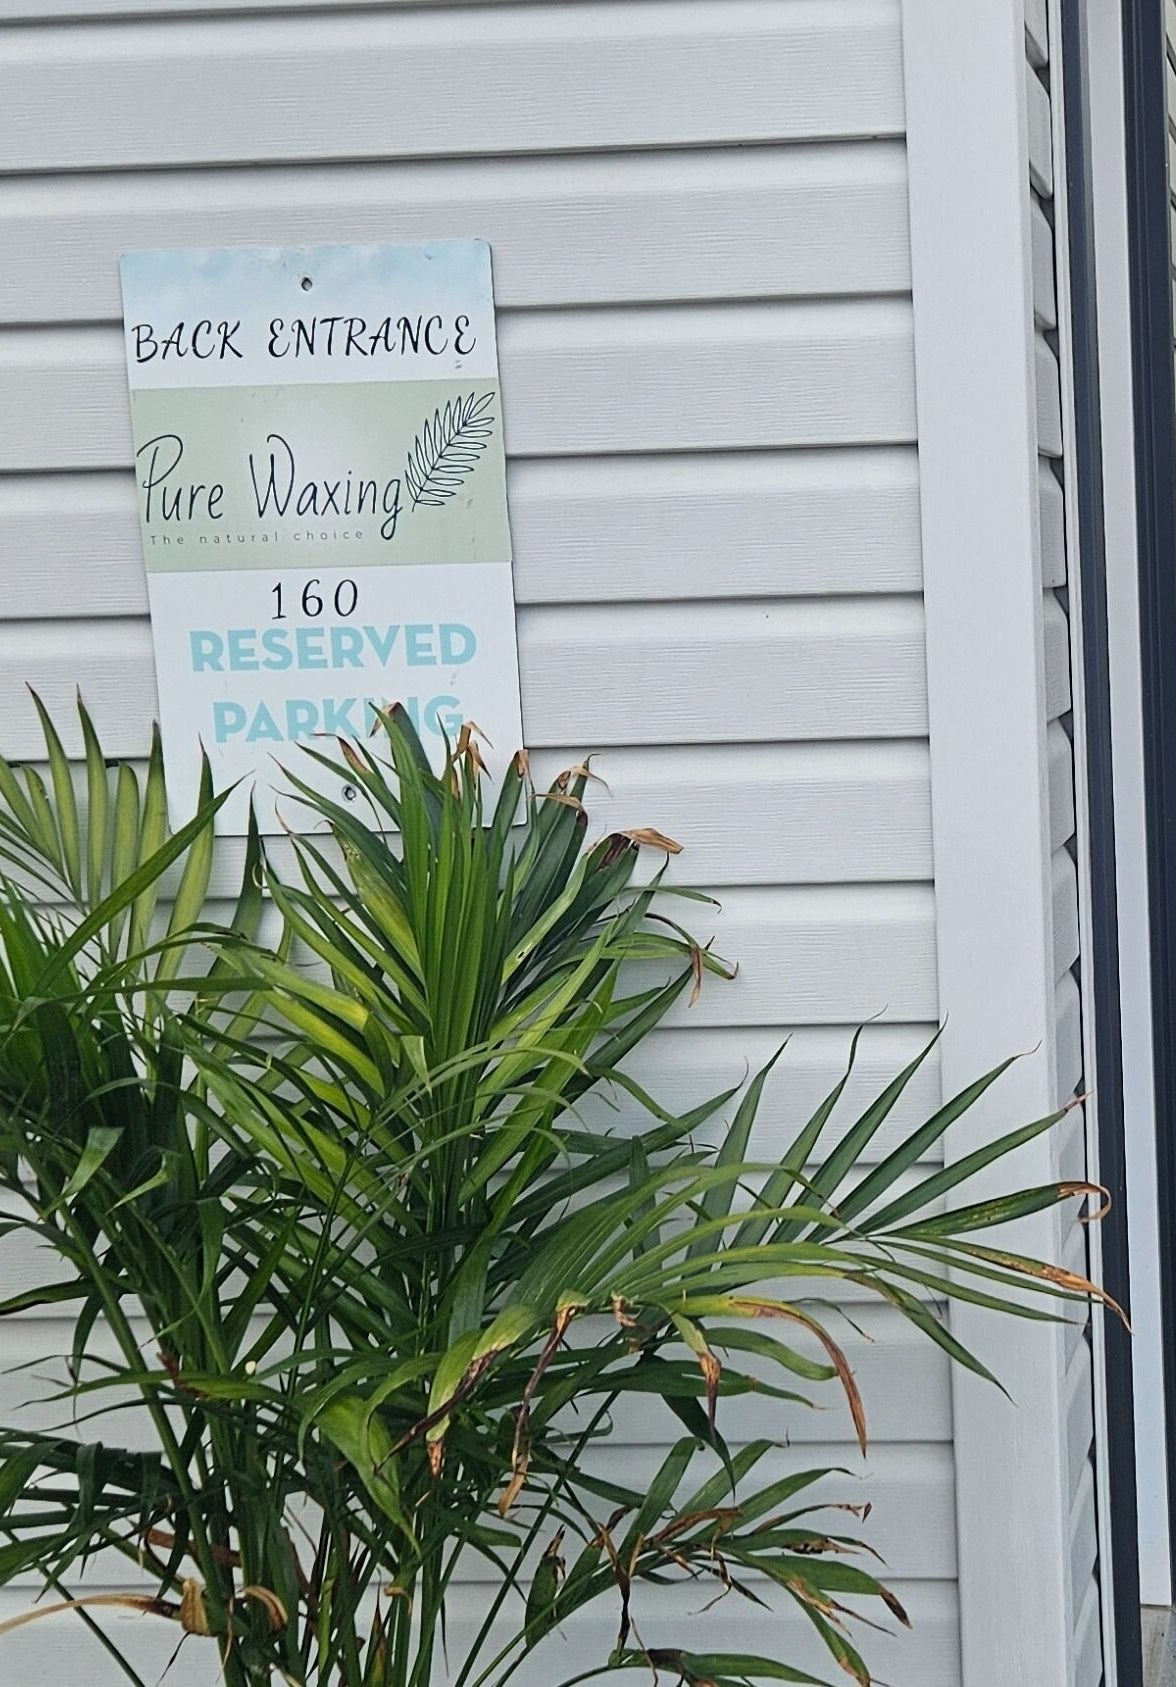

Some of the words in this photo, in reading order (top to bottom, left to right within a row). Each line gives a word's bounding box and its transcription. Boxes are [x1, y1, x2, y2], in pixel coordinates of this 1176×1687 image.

[131, 320, 243, 363] BACK
[268, 314, 477, 359] ENTRANCE
[136, 434, 225, 524] Pure
[249, 433, 404, 541] Waxing
[150, 535, 185, 546] The
[199, 531, 279, 545] natural
[293, 529, 364, 542] choice
[271, 578, 359, 620] 160
[189, 623, 477, 673] RESERVED
